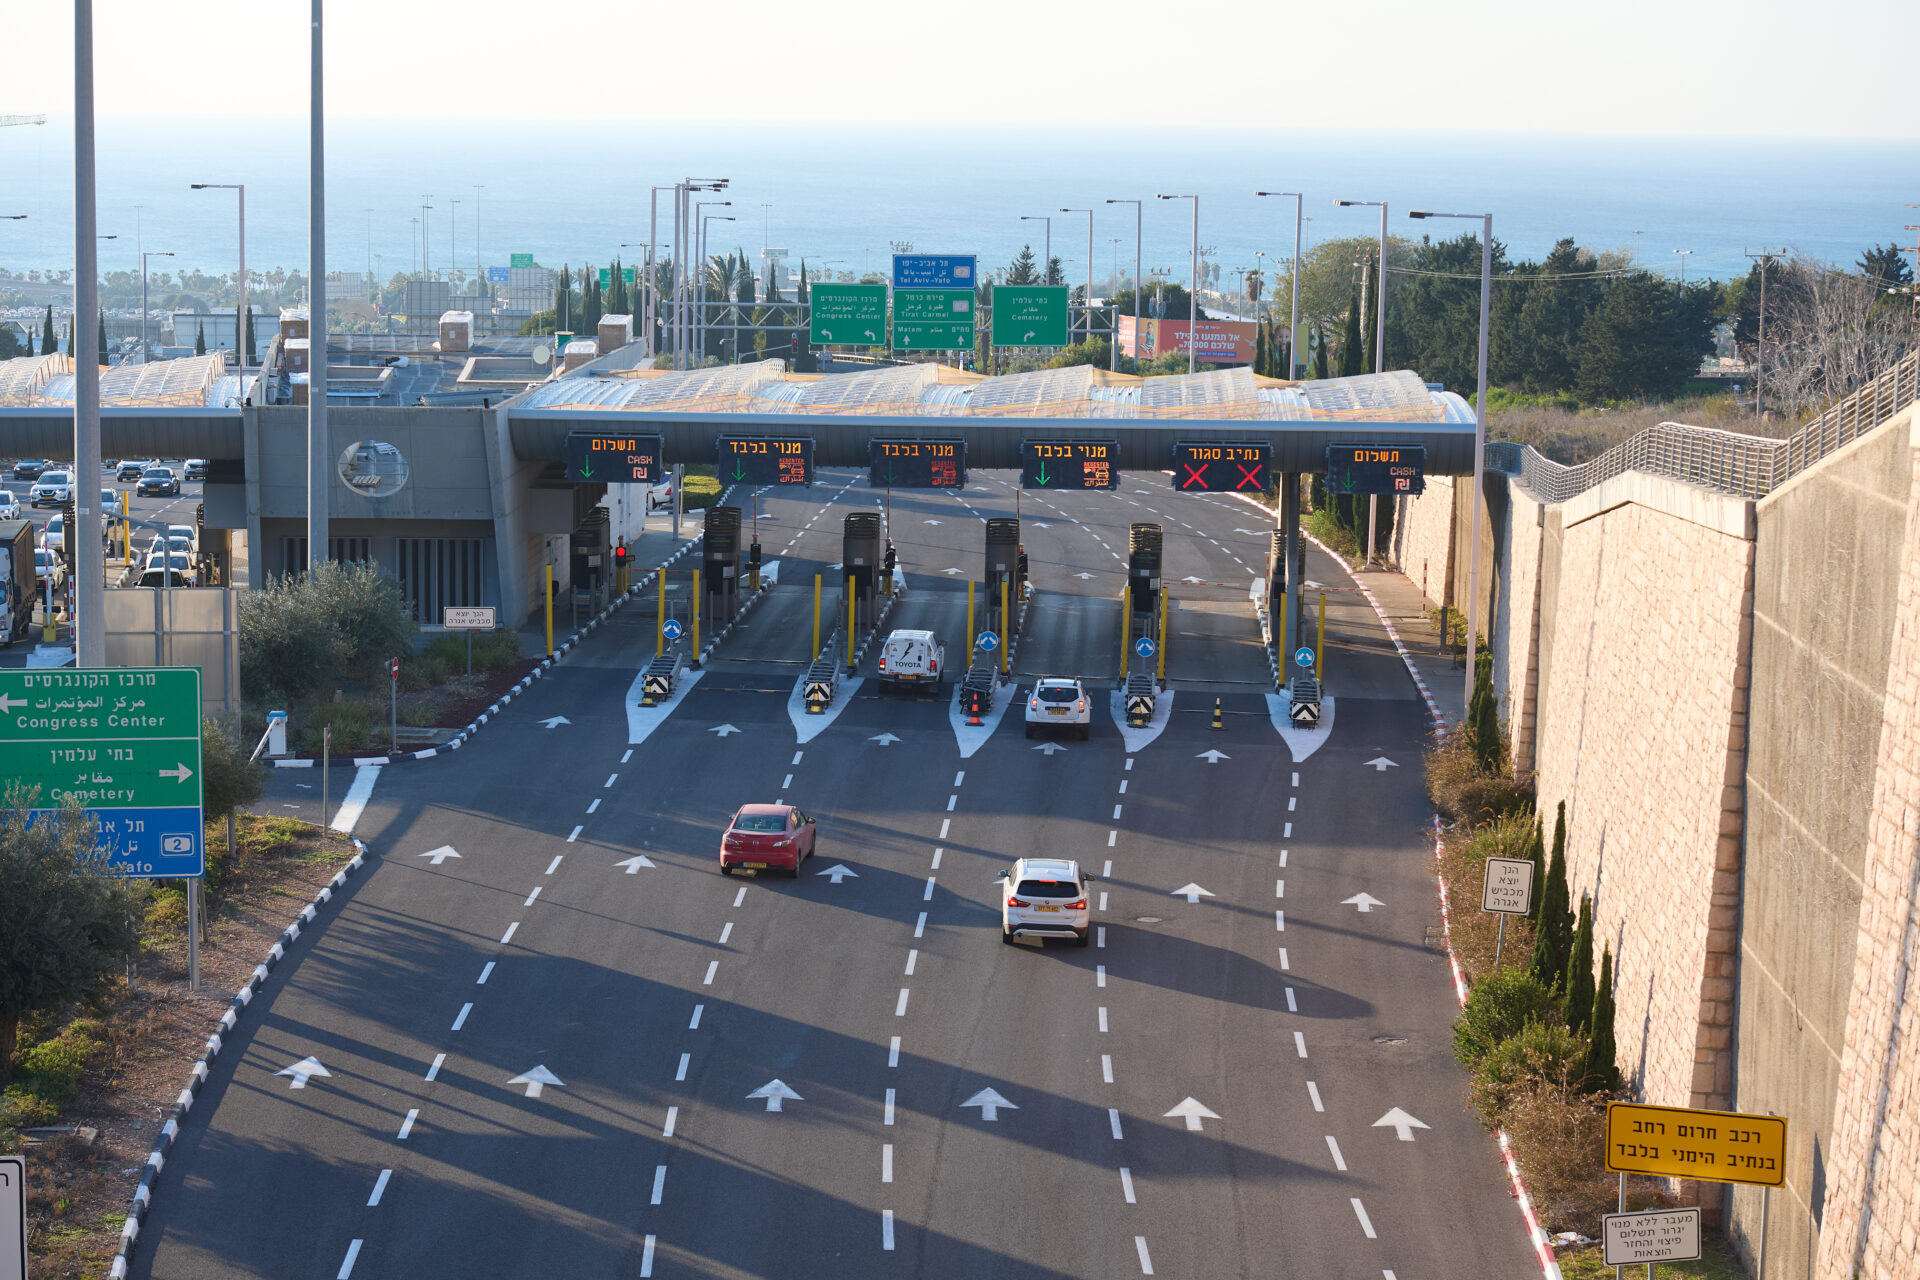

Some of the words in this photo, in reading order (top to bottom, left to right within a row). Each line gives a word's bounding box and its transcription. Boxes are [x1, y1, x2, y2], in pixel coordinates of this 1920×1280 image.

[592, 440, 636, 450] תשלום
[730, 442, 768, 454] בלבד
[773, 442, 802, 454] מנוי
[882, 444, 920, 456] בלבד
[925, 444, 954, 456] מנוי
[1034, 446, 1072, 457] בלבד
[1078, 446, 1106, 458] מנוי
[1188, 448, 1220, 460] סגור
[1226, 448, 1260, 460] נתיב
[1354, 450, 1399, 462] תשלום
[628, 456, 652, 464] CASH
[1390, 466, 1416, 476] CASH
[24, 674, 110, 688] הקונגרסים
[119, 674, 156, 686] מרכז
[35, 696, 103, 712] المؤتمرات
[112, 696, 146, 712] مركز
[17, 716, 98, 730] Congress
[108, 715, 165, 728] Center
[51, 748, 96, 764] עלמין
[107, 748, 134, 761] בתי
[74, 772, 114, 784] مقابر
[51, 788, 134, 802] Cemetery
[126, 818, 144, 832] תל
[122, 840, 138, 856] تل
[173, 838, 182, 850] 2
[1502, 866, 1518, 875] הנך
[1499, 876, 1519, 884] יוצא
[1492, 888, 1524, 896] מכביש
[1494, 898, 1518, 907] אגרה
[1632, 1120, 1666, 1134] רחב
[1678, 1124, 1717, 1140] חרום
[1728, 1130, 1761, 1144] רכב
[1616, 1144, 1660, 1159] בלבד
[1672, 1149, 1715, 1164] הימני
[1728, 1154, 1776, 1170] בנתיב
[1612, 1220, 1630, 1228] מנוי
[1636, 1217, 1658, 1226] ללא
[1664, 1215, 1693, 1224] מעבר
[1620, 1229, 1655, 1238] תשלום
[1661, 1226, 1684, 1234] יגרור
[1624, 1240, 1652, 1248] והחזר
[1658, 1237, 1682, 1246] פיצוי
[1634, 1248, 1672, 1258] הוצאות
